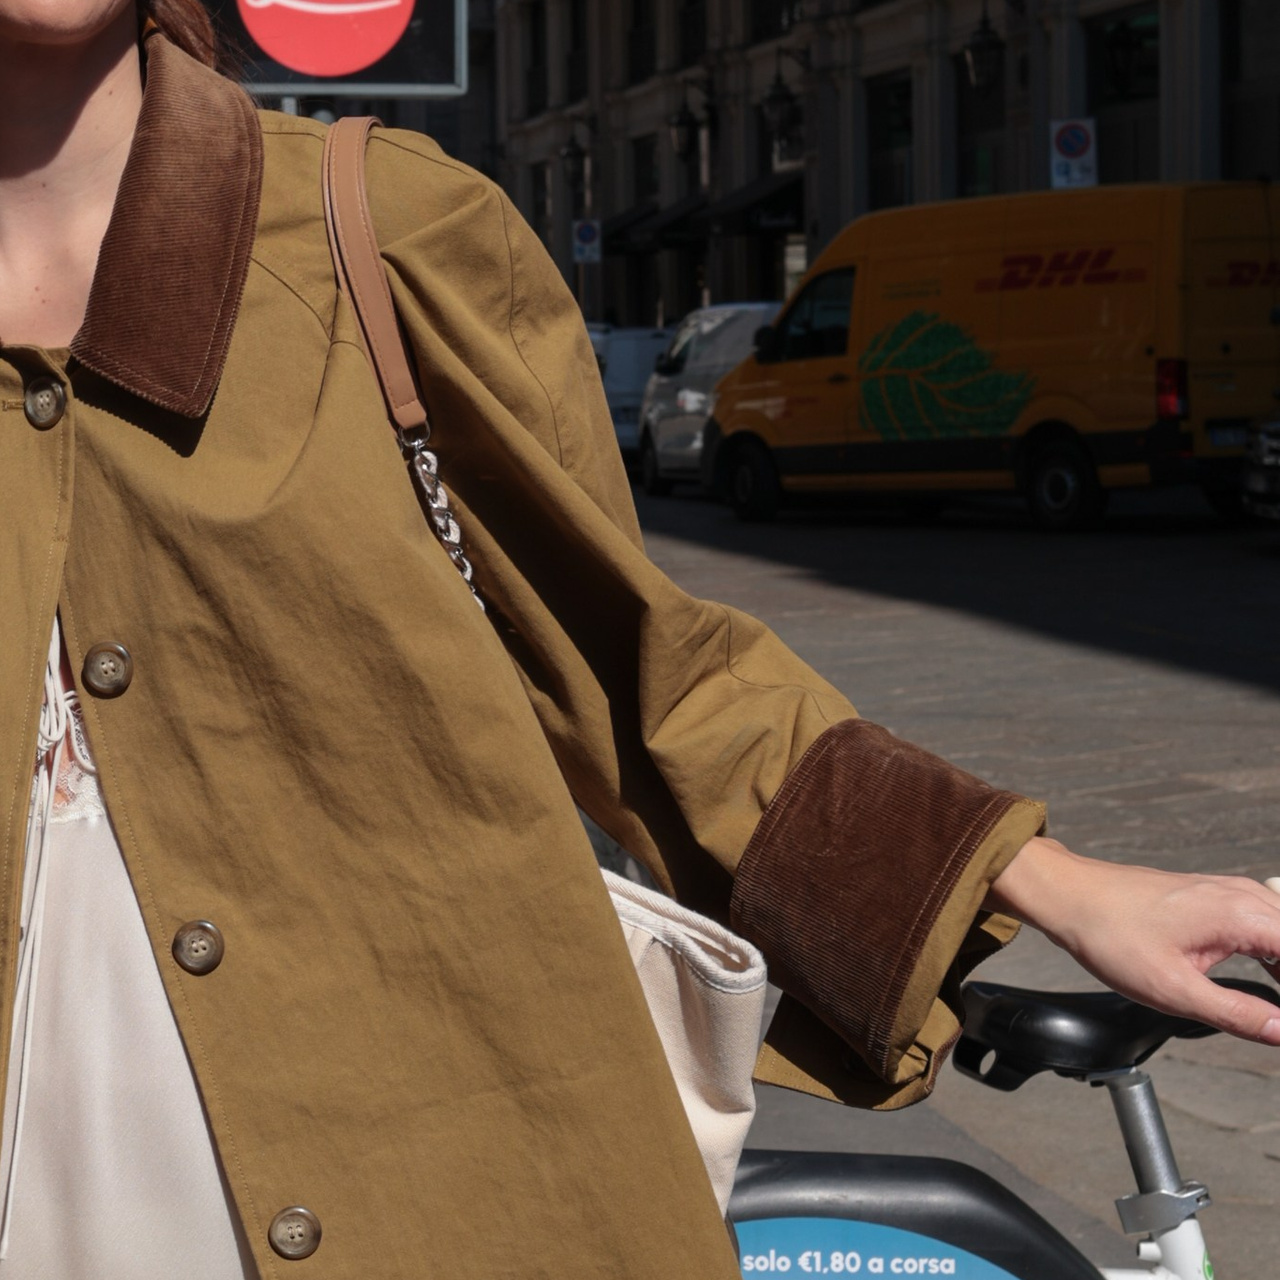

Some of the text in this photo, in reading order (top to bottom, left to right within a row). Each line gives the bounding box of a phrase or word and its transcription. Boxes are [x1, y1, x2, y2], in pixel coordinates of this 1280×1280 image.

[999, 247, 1119, 290] DHL
[743, 1249, 956, 1274] solo €1,80 a corsa
